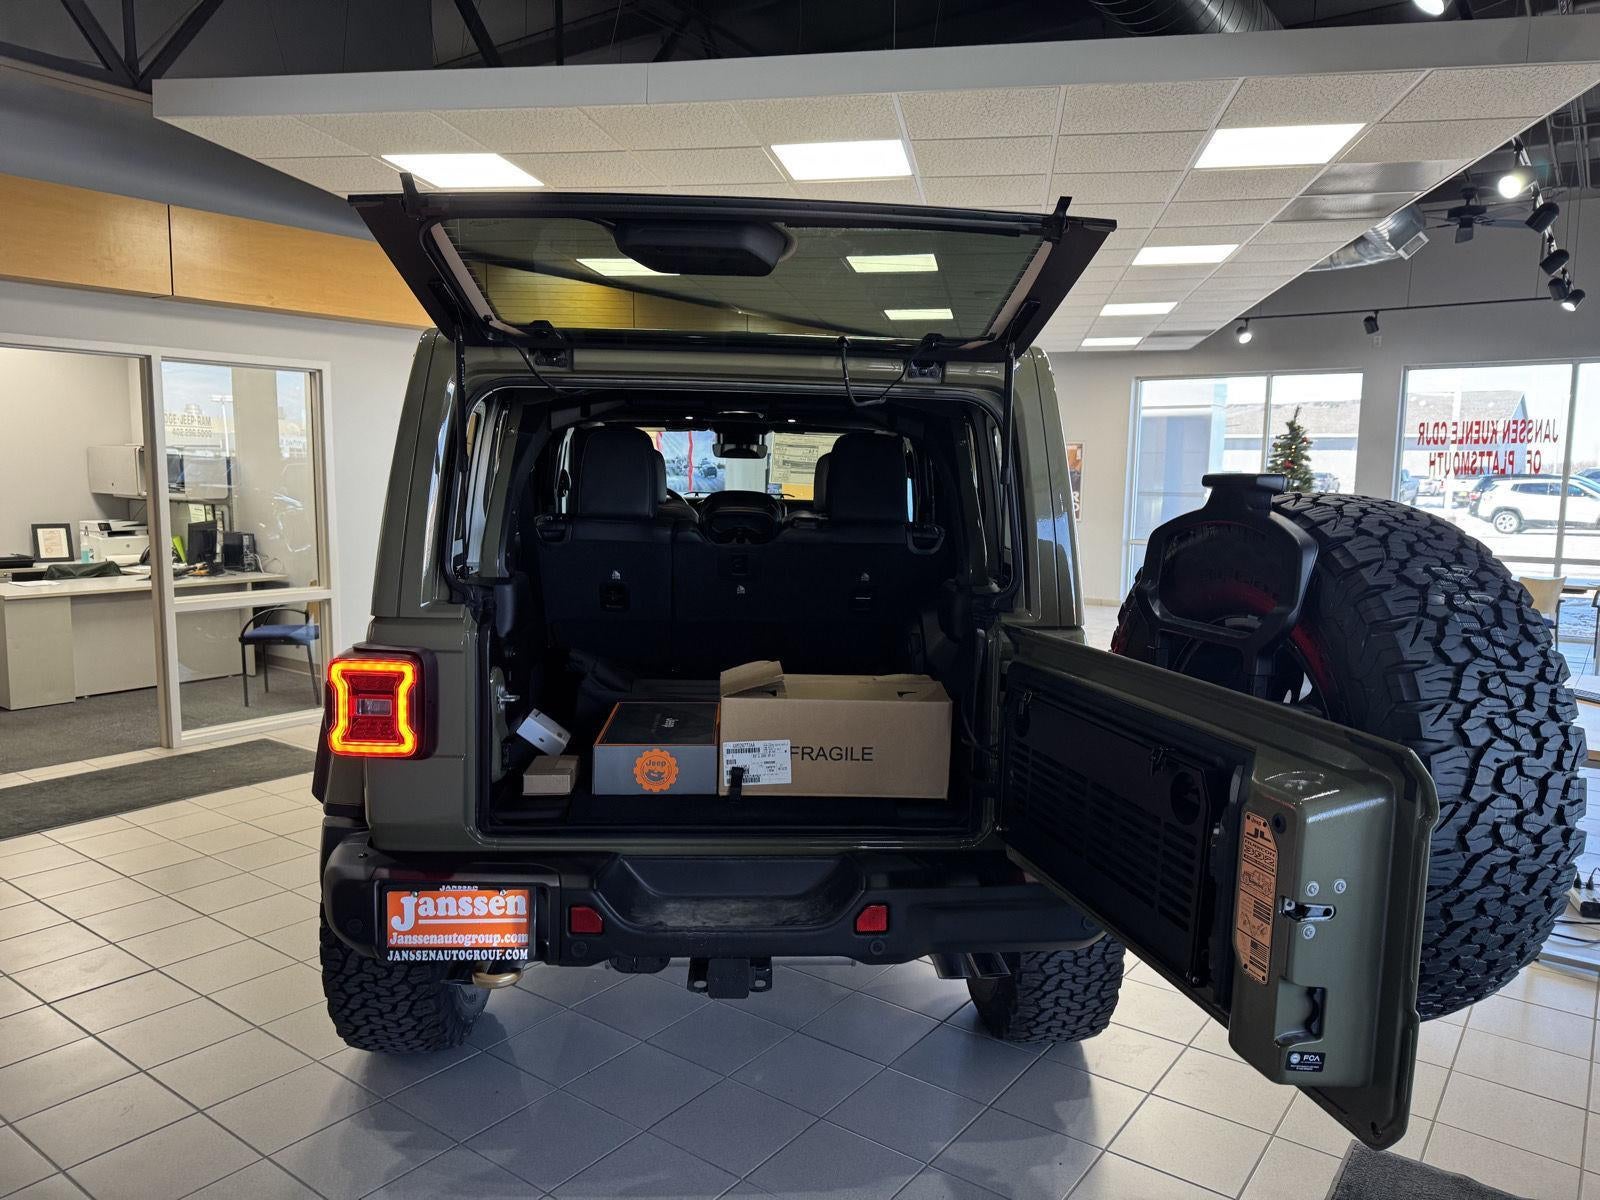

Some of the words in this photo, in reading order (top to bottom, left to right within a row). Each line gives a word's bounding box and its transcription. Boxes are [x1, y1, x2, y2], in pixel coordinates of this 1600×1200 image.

[790, 745, 874, 761] FRAGILE
[645, 760, 667, 768] Jeep
[1246, 828, 1271, 843] JL
[391, 895, 527, 931] Janssen
[390, 932, 528, 947] Janssenautogroup.com
[387, 949, 528, 961] JANSSENAUTOGROUP.COM
